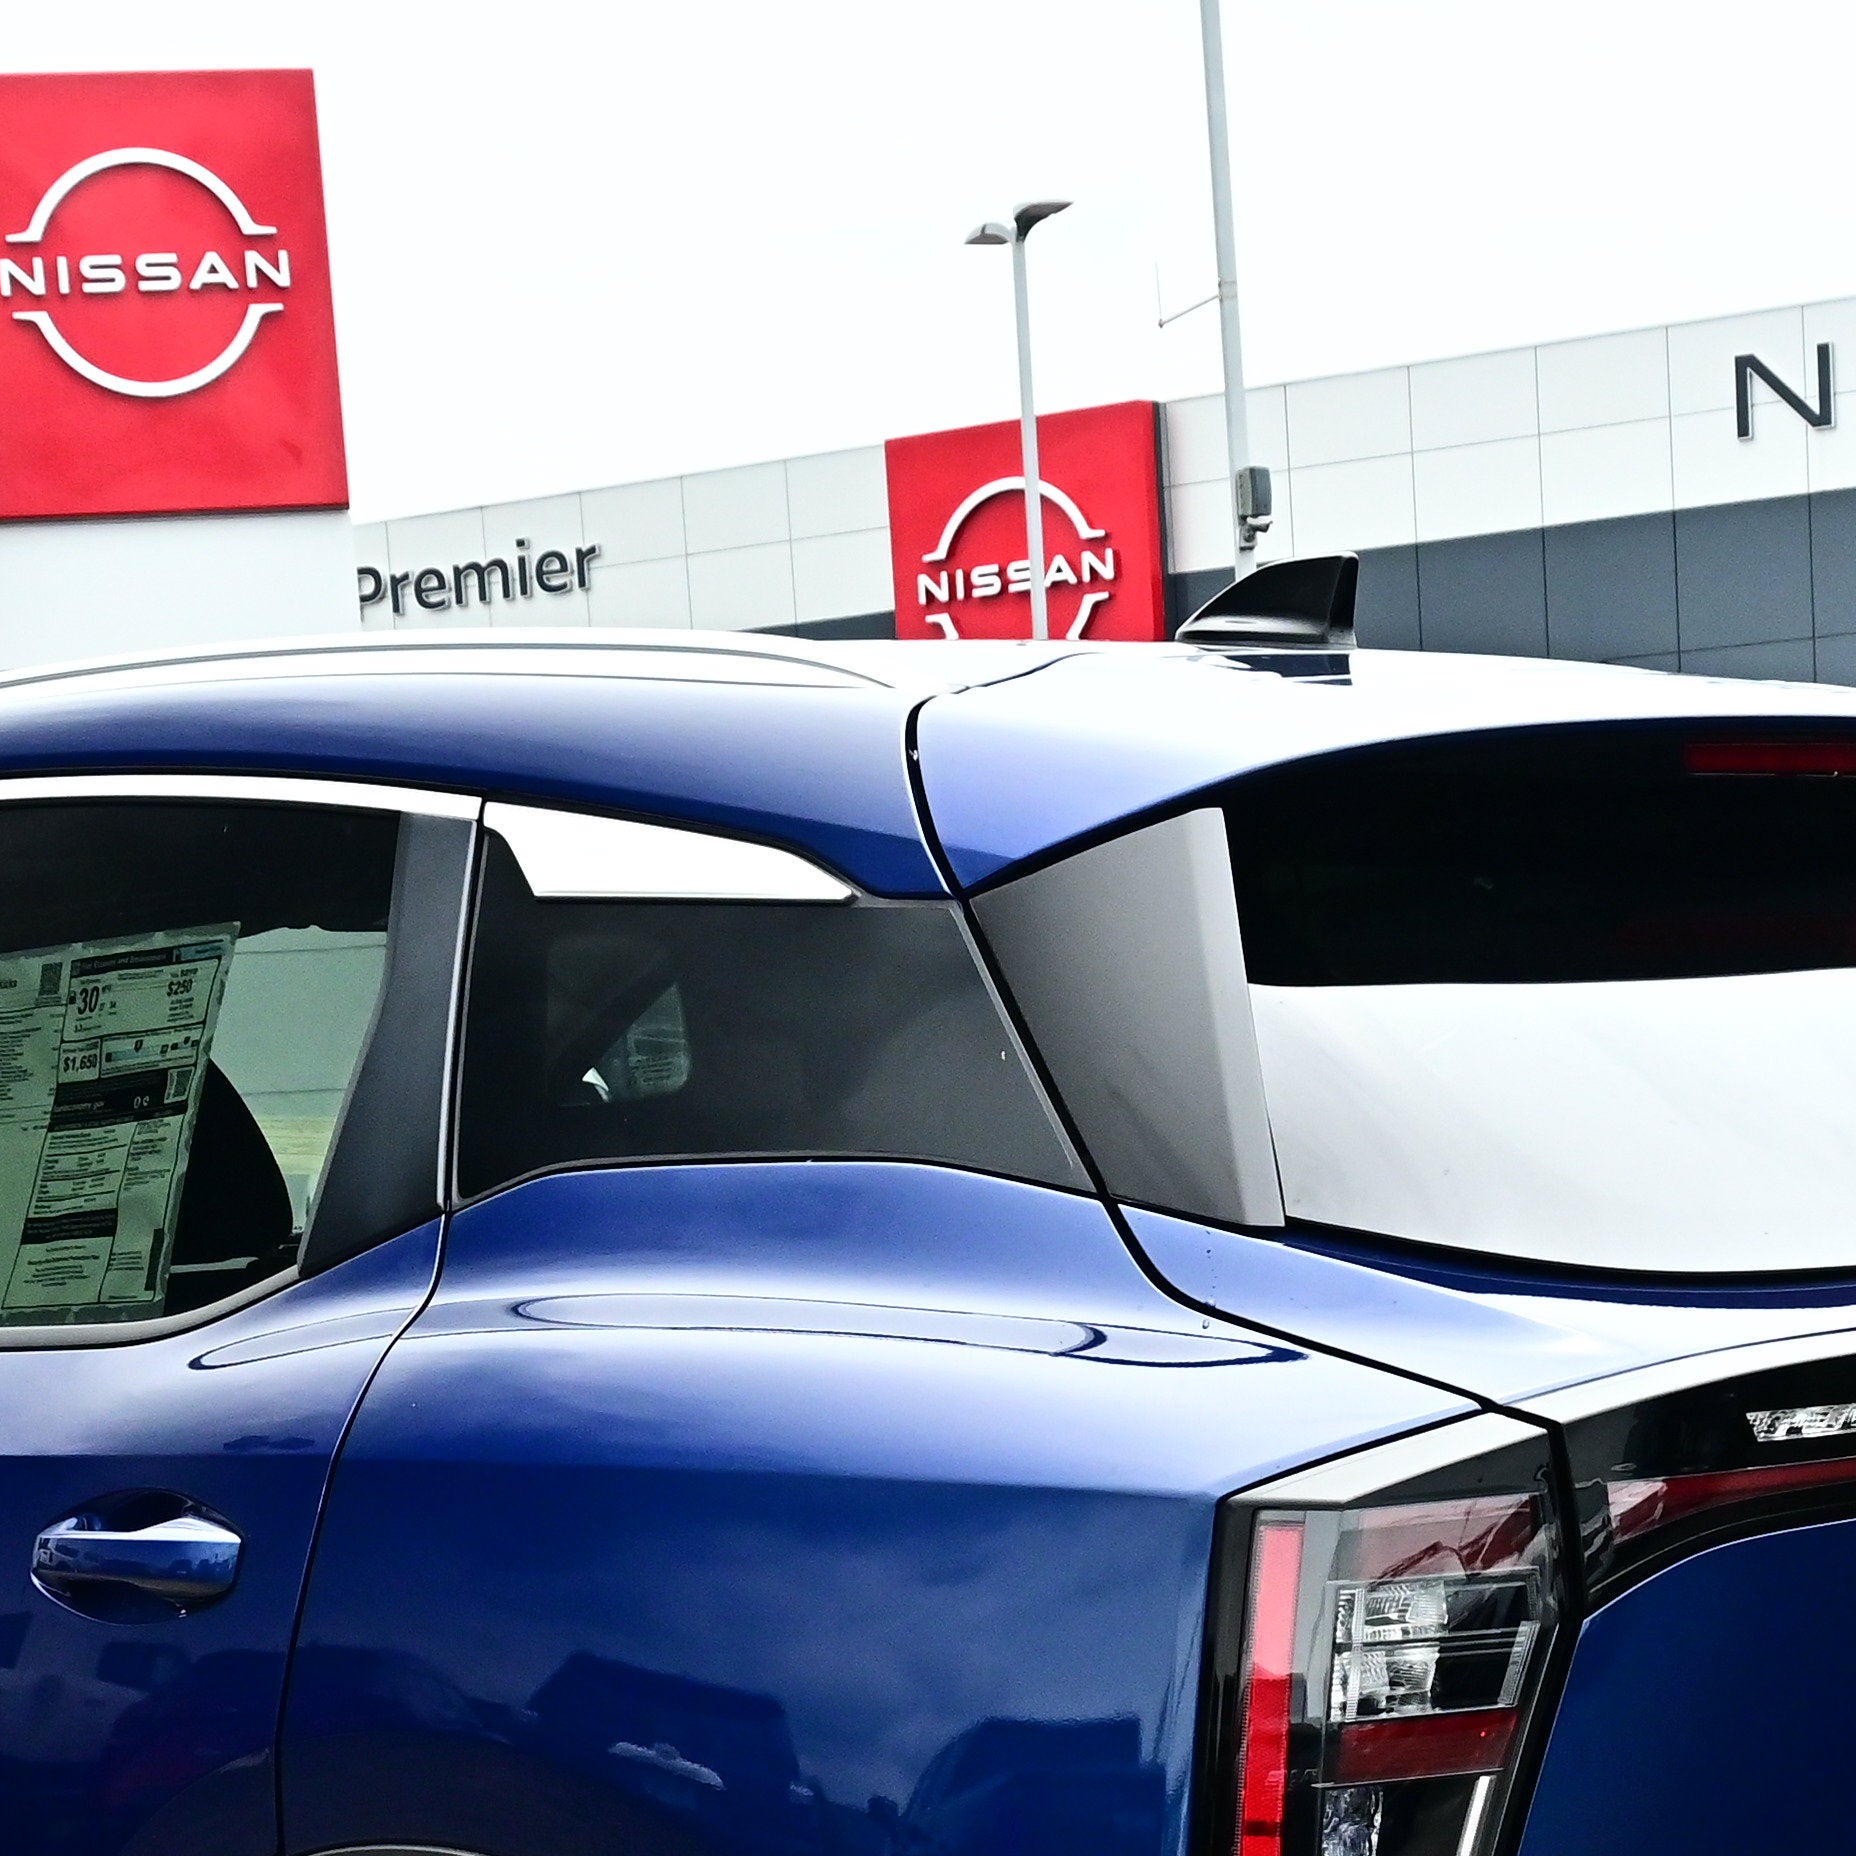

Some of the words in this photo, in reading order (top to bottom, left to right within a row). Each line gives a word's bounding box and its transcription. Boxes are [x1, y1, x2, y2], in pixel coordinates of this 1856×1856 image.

[356, 538, 597, 615] Premier
[917, 548, 1115, 605] NISSAN
[77, 986, 100, 1015] 30
